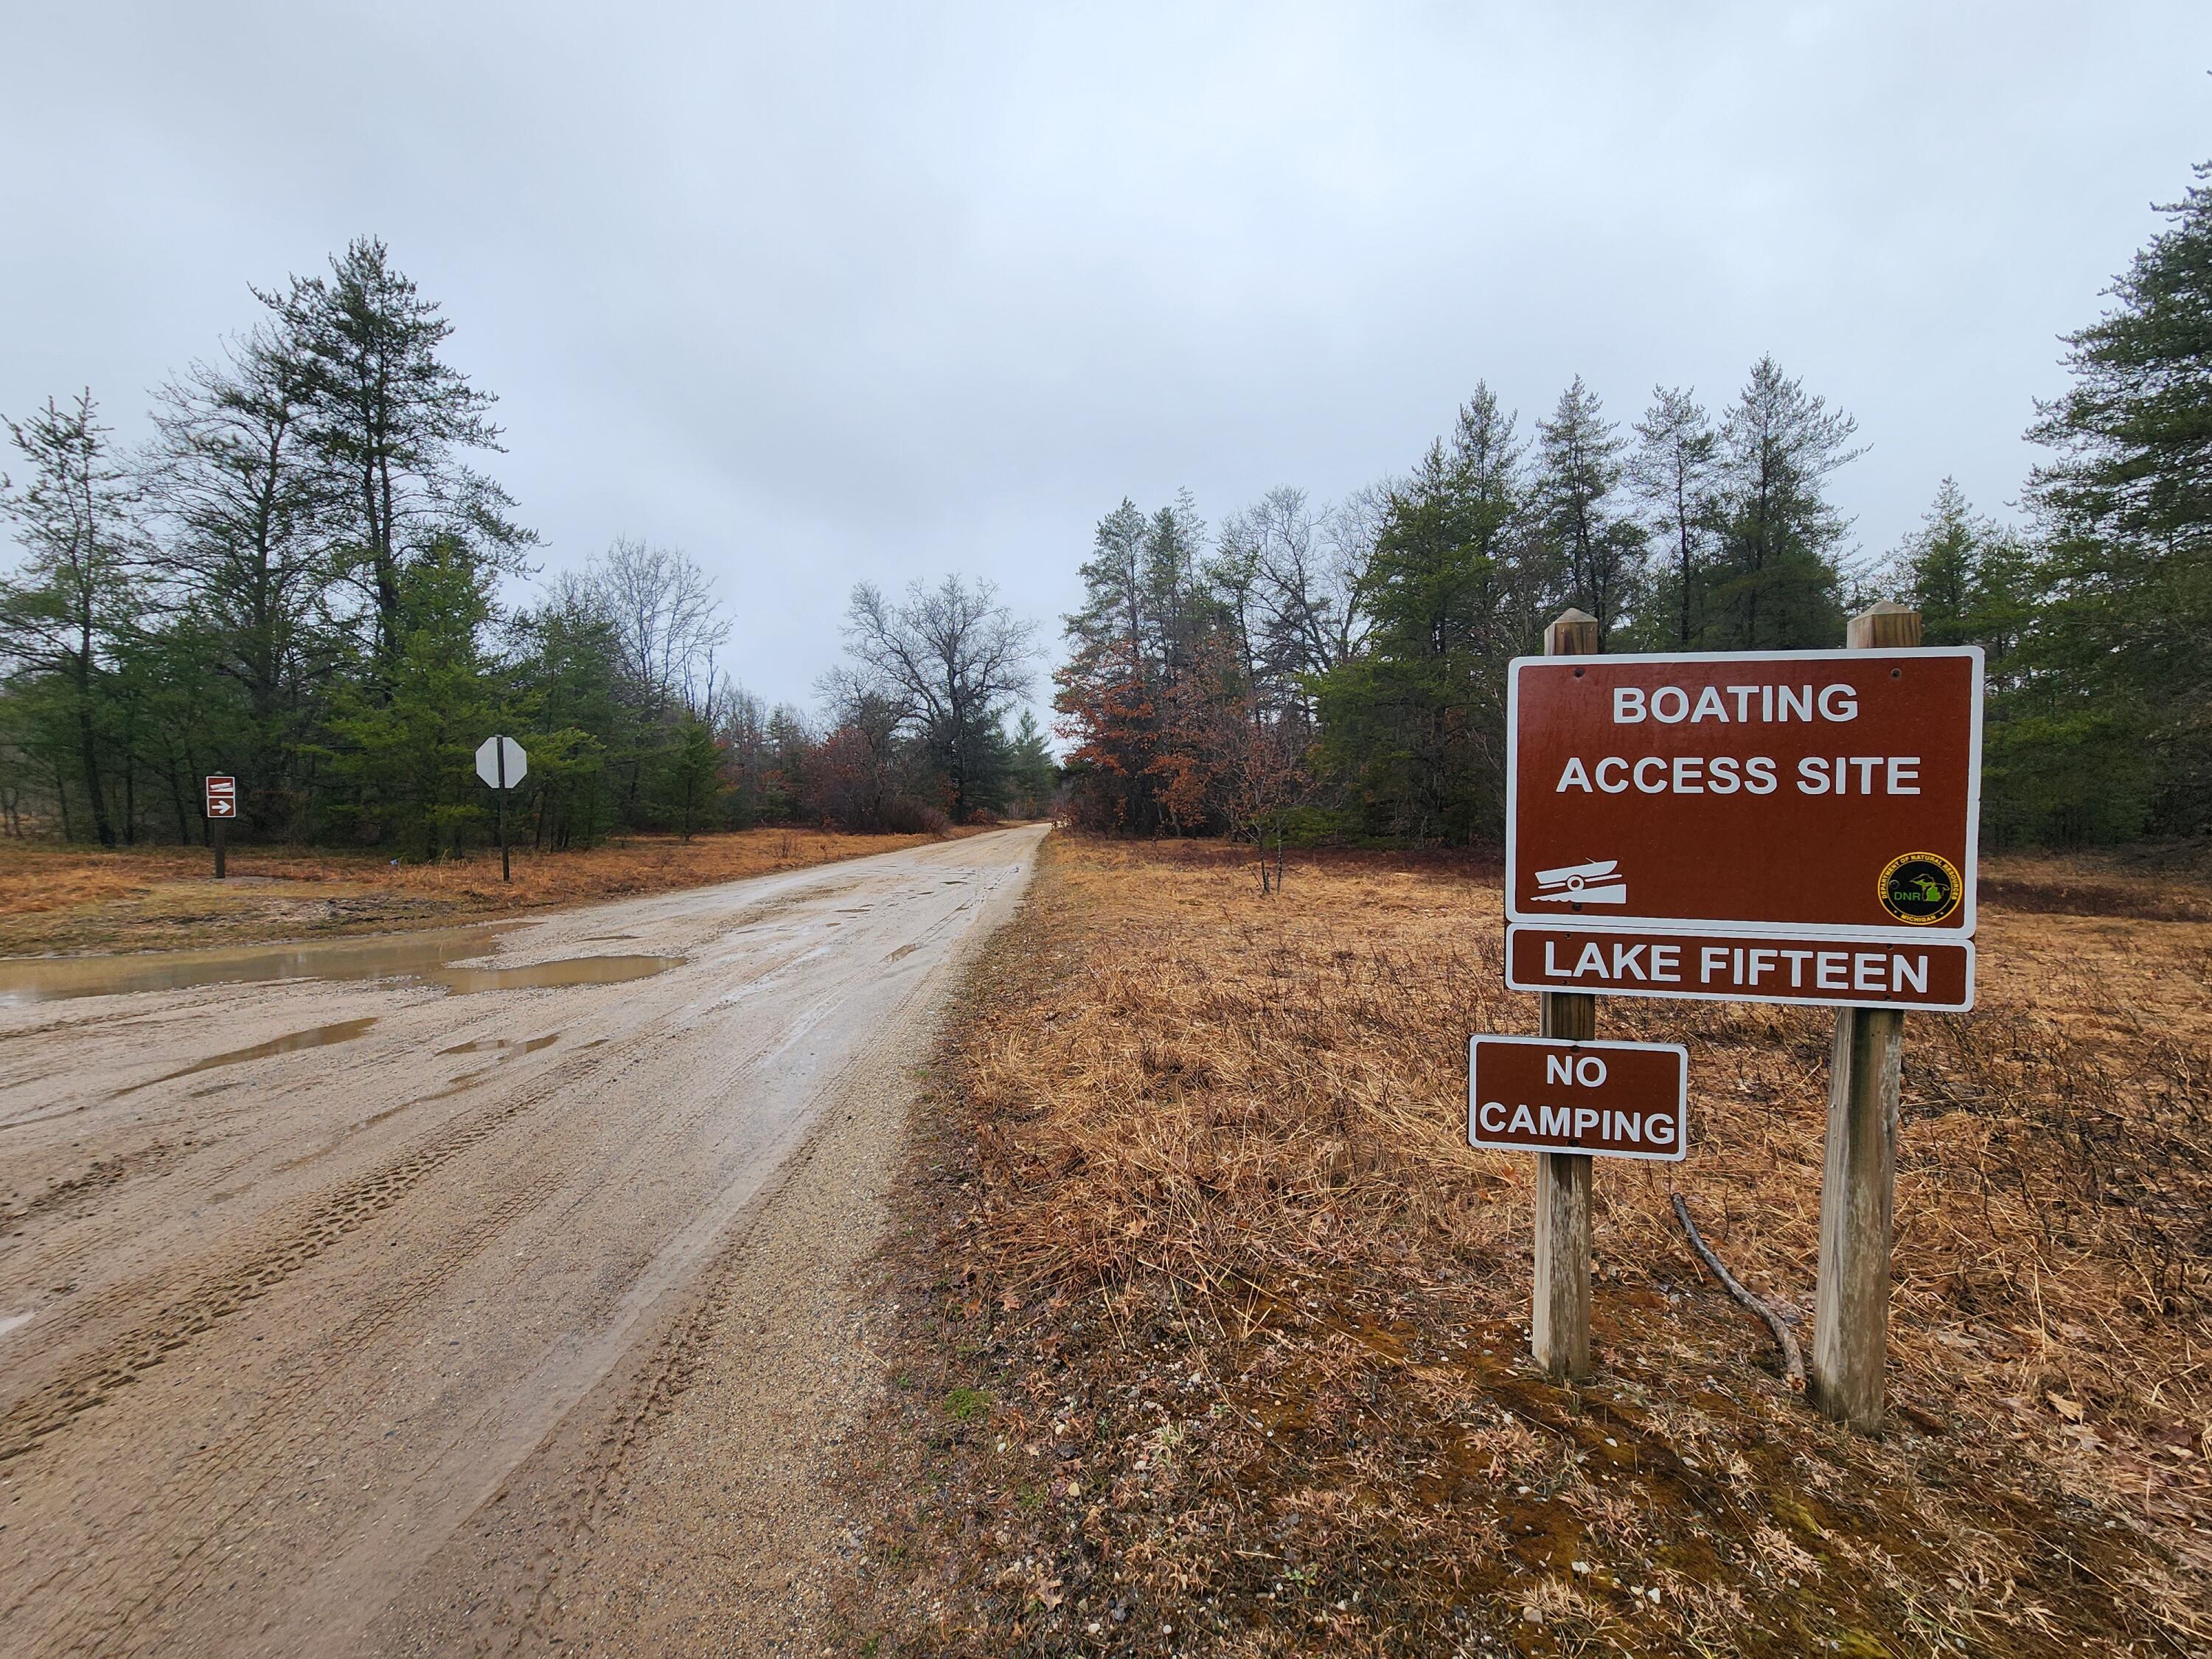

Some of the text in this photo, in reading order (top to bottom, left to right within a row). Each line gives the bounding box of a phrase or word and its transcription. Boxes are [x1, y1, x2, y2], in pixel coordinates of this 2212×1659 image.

[1613, 684, 1858, 723] BOATING
[1557, 757, 1921, 795] ACCESS SITE
[1880, 862, 1900, 899] DEPARTMENT
[1911, 855, 1942, 866] NATURAL
[1942, 863, 1959, 900] RESOURCES
[1894, 891, 1921, 901] DNR
[1901, 914, 1936, 922] MICHIGAN
[1545, 941, 1928, 993] LAKE FIFTEEN
[1546, 1054, 1607, 1088] NO
[1479, 1102, 1675, 1145] CAMPING
